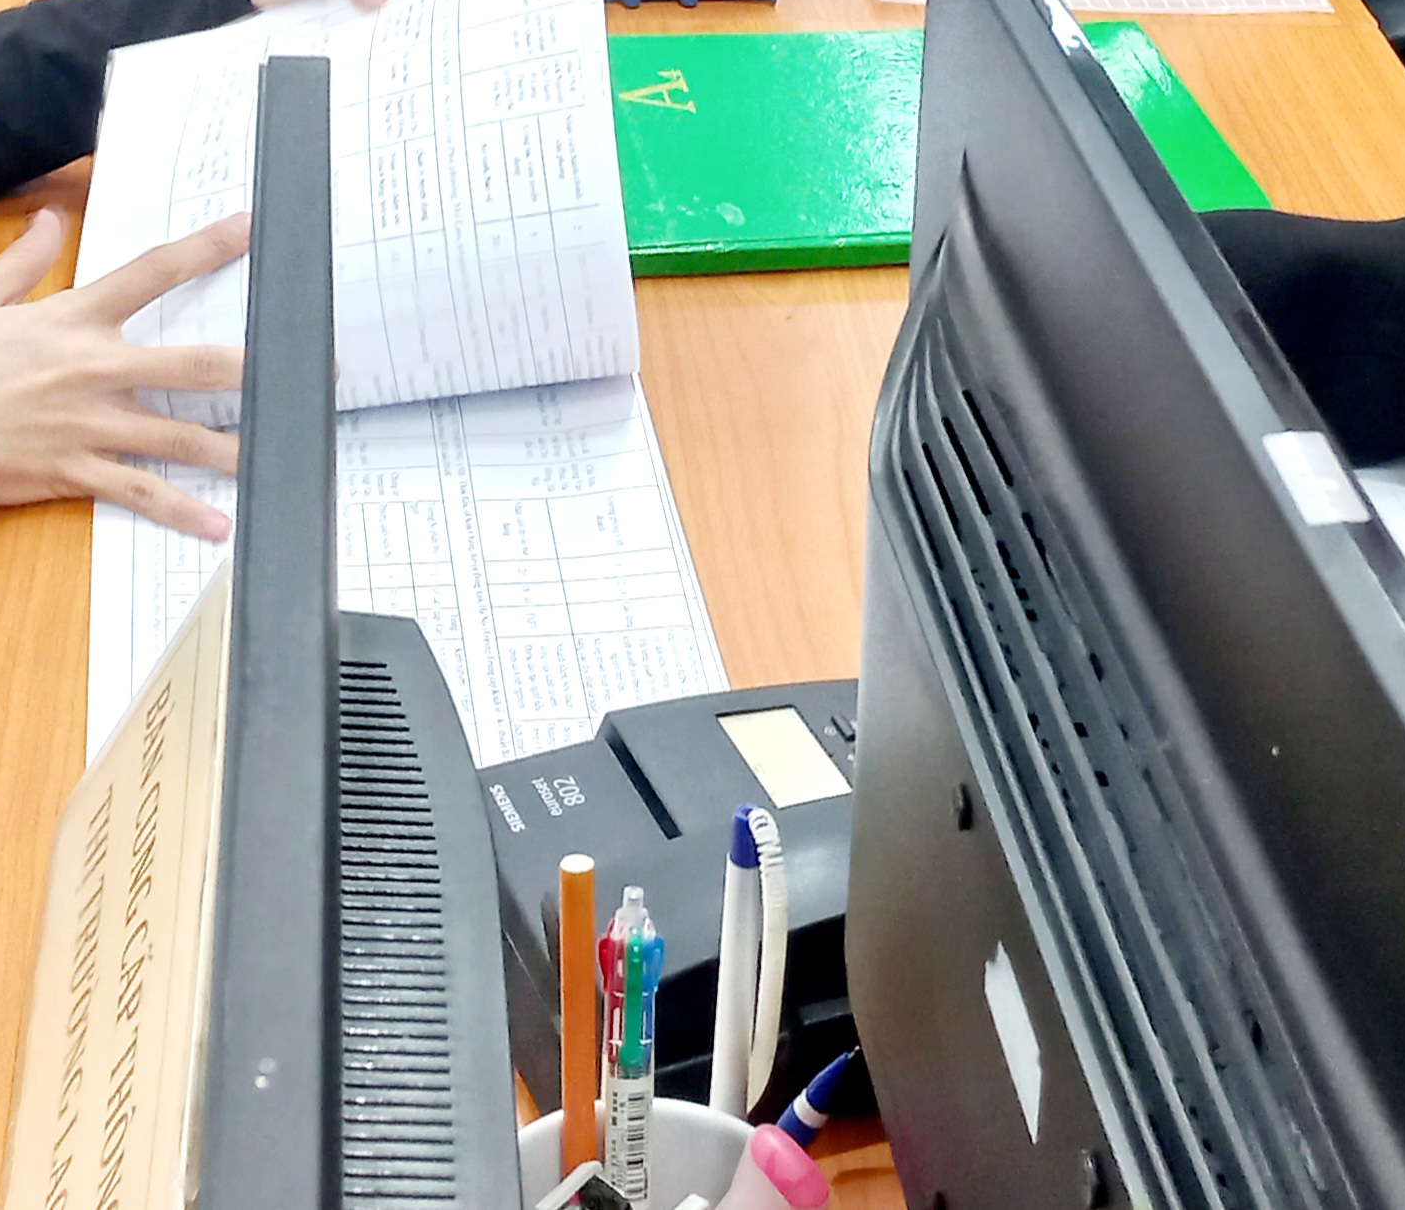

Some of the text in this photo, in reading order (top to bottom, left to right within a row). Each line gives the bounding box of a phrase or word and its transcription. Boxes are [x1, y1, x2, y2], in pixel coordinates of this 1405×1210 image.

[488, 784, 526, 833] SIEMENS
[531, 777, 563, 817] euroset
[553, 775, 586, 807] 802
[125, 781, 160, 926] CUNG
[115, 919, 153, 1026] CẤP
[95, 1024, 139, 1210] THÔN
